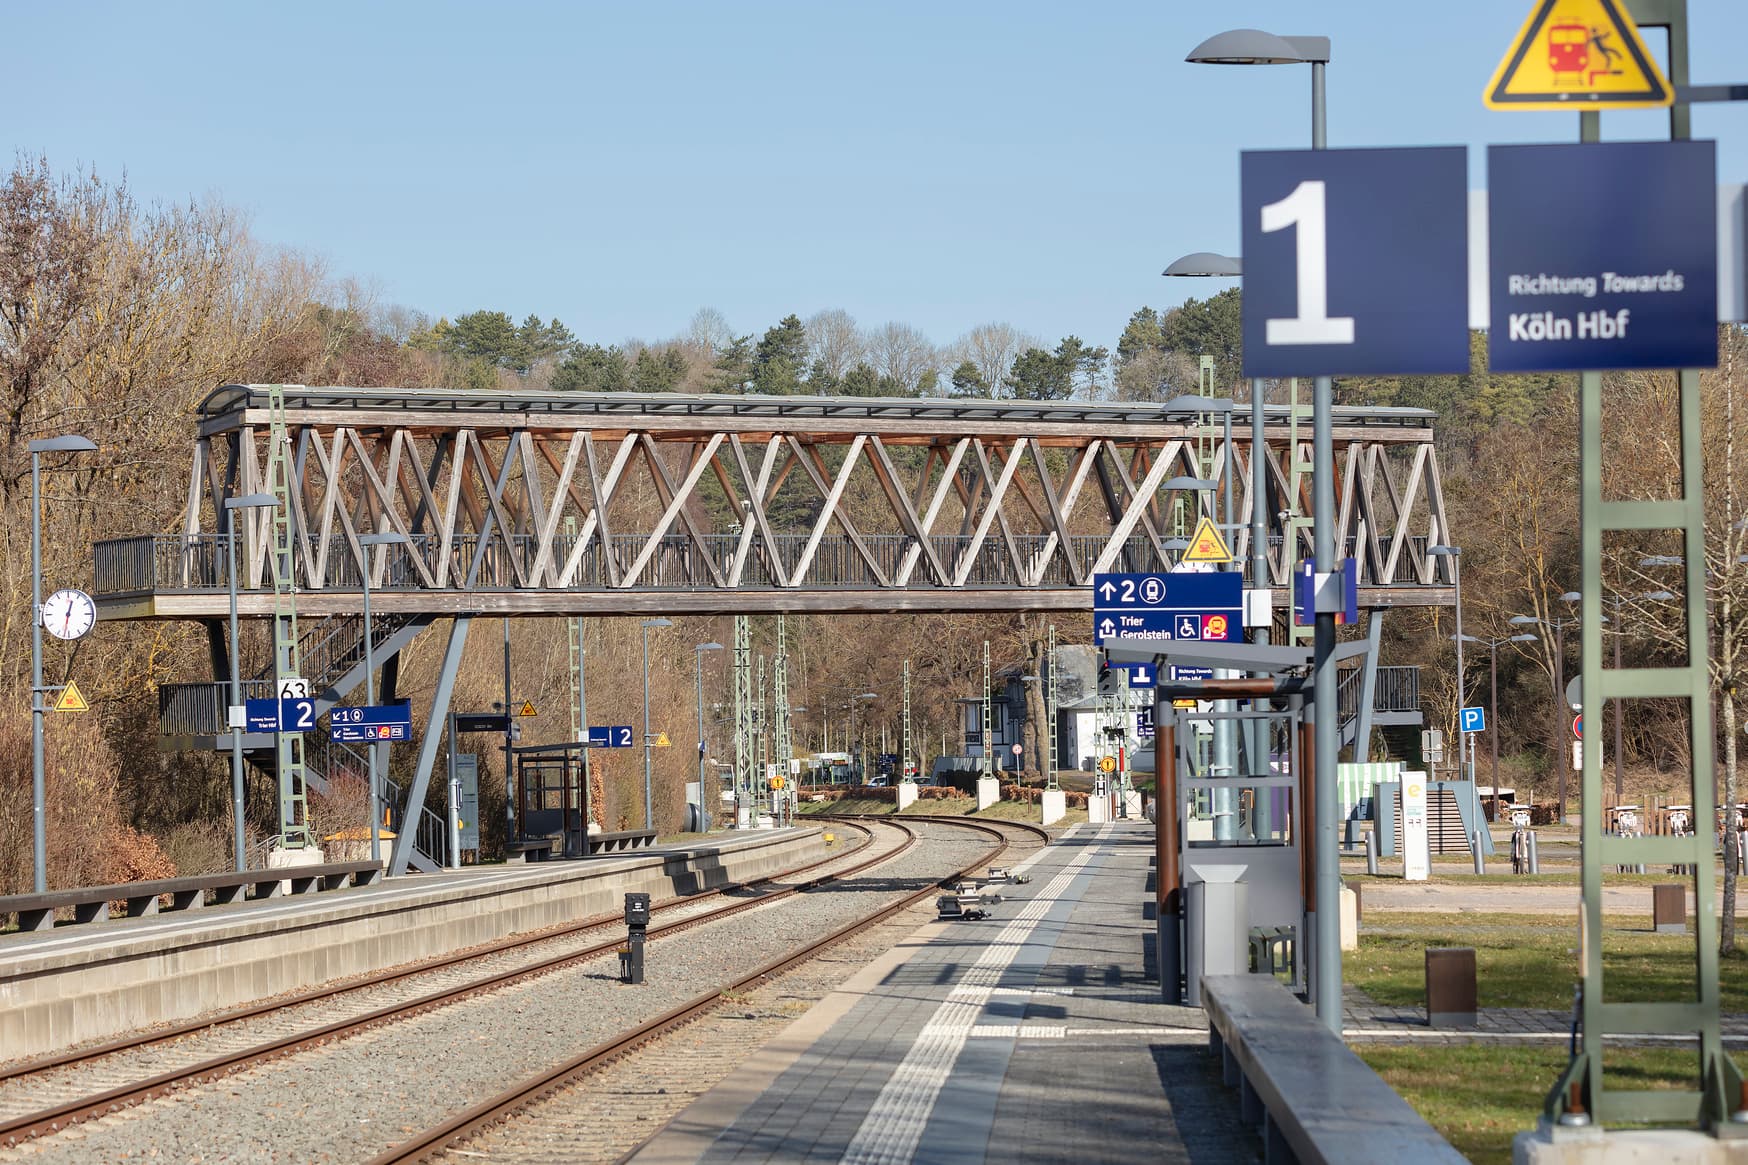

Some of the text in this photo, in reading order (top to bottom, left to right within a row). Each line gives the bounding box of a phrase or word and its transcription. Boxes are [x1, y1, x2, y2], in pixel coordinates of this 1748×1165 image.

[1261, 181, 1354, 345] 1
[1508, 269, 1684, 297] Richtung Towards
[1509, 309, 1630, 341] Köln Hbf
[1120, 580, 1135, 602] 2
[1120, 616, 1144, 626] Trier
[1120, 629, 1171, 640] Gerolstein
[281, 683, 306, 698] 63
[296, 702, 313, 727] 2
[342, 710, 350, 722] 1
[1144, 708, 1154, 726] 1
[1465, 711, 1478, 729] P
[620, 728, 631, 745] 2
[1096, 782, 1106, 795] H
